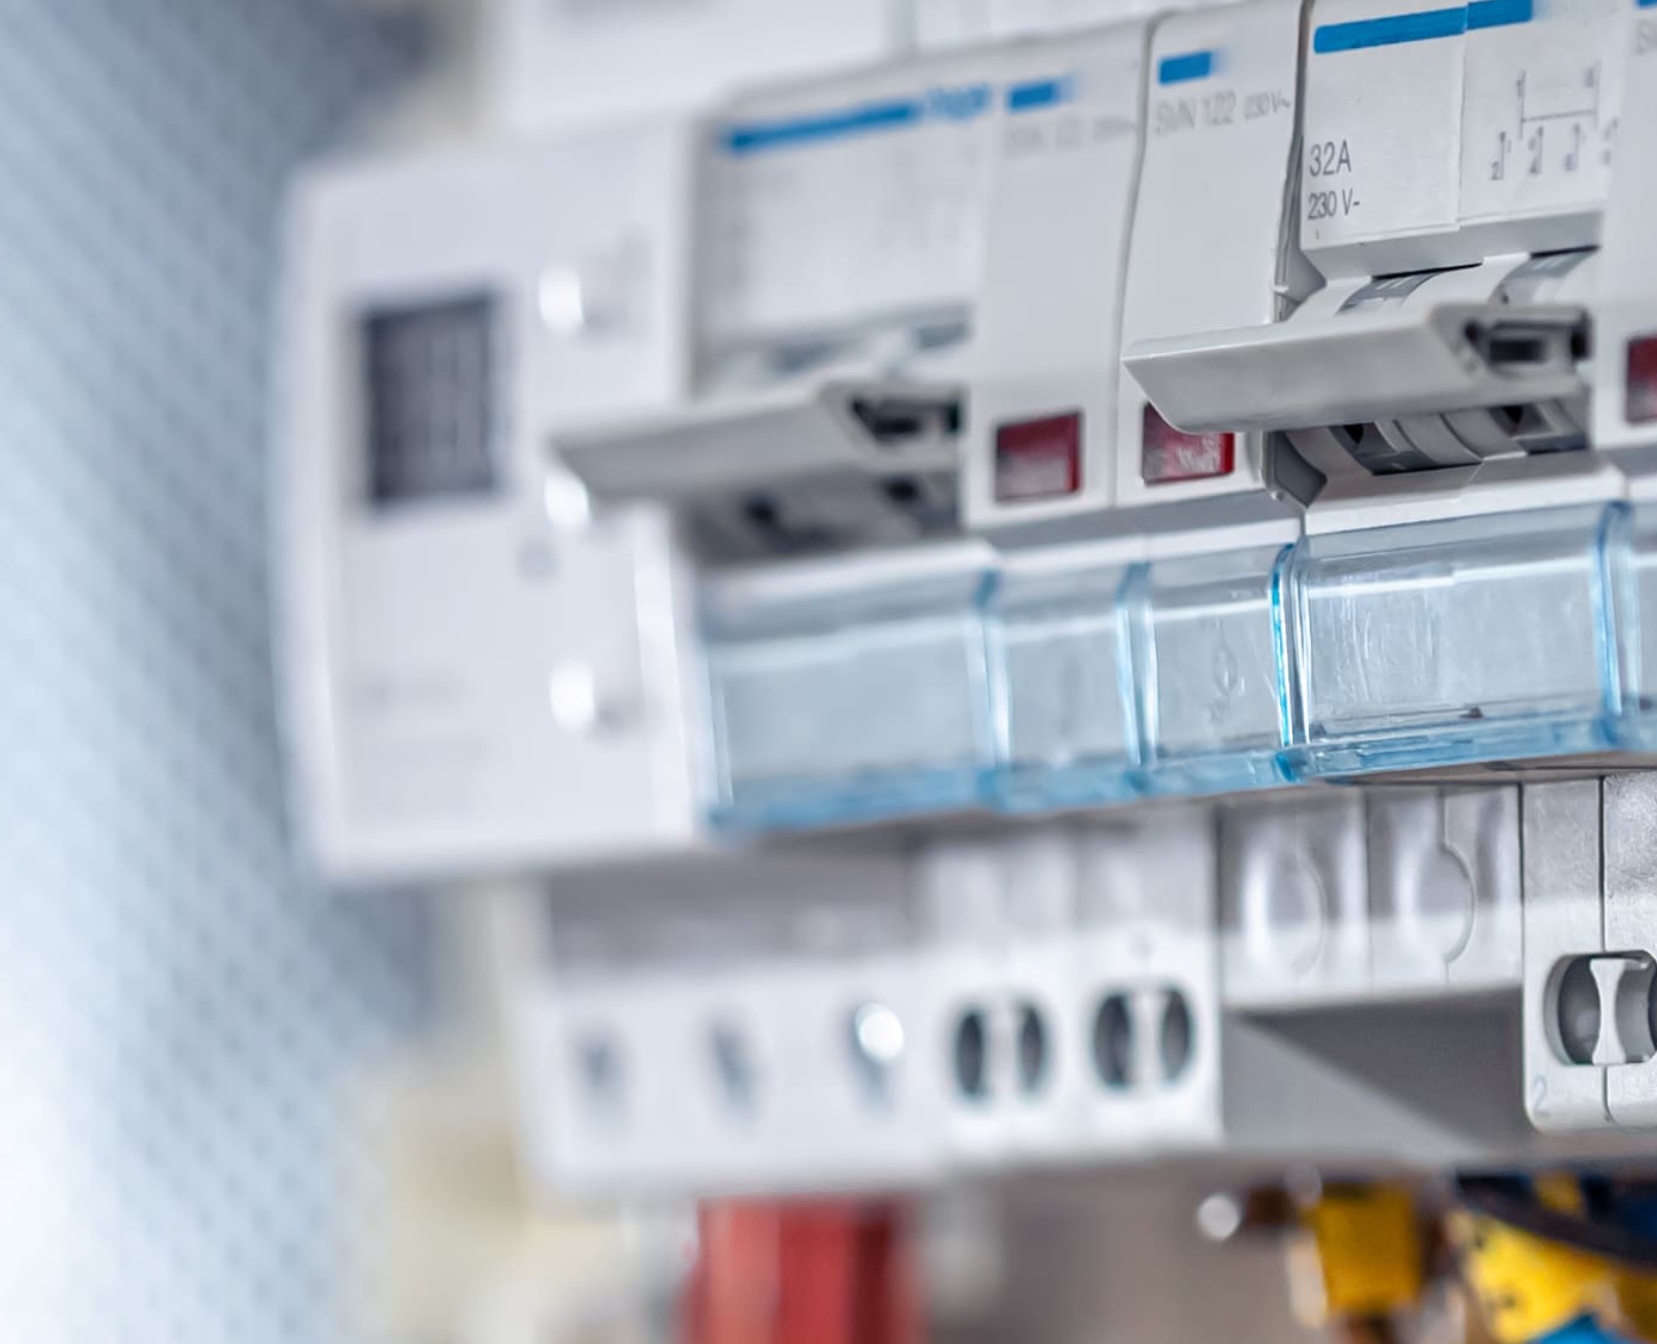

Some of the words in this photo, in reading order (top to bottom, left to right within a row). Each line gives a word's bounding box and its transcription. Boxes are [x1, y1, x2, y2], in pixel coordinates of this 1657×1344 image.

[1308, 138, 1352, 176] 32A
[1307, 190, 1338, 220] 230
[1533, 1074, 1550, 1116] 2
